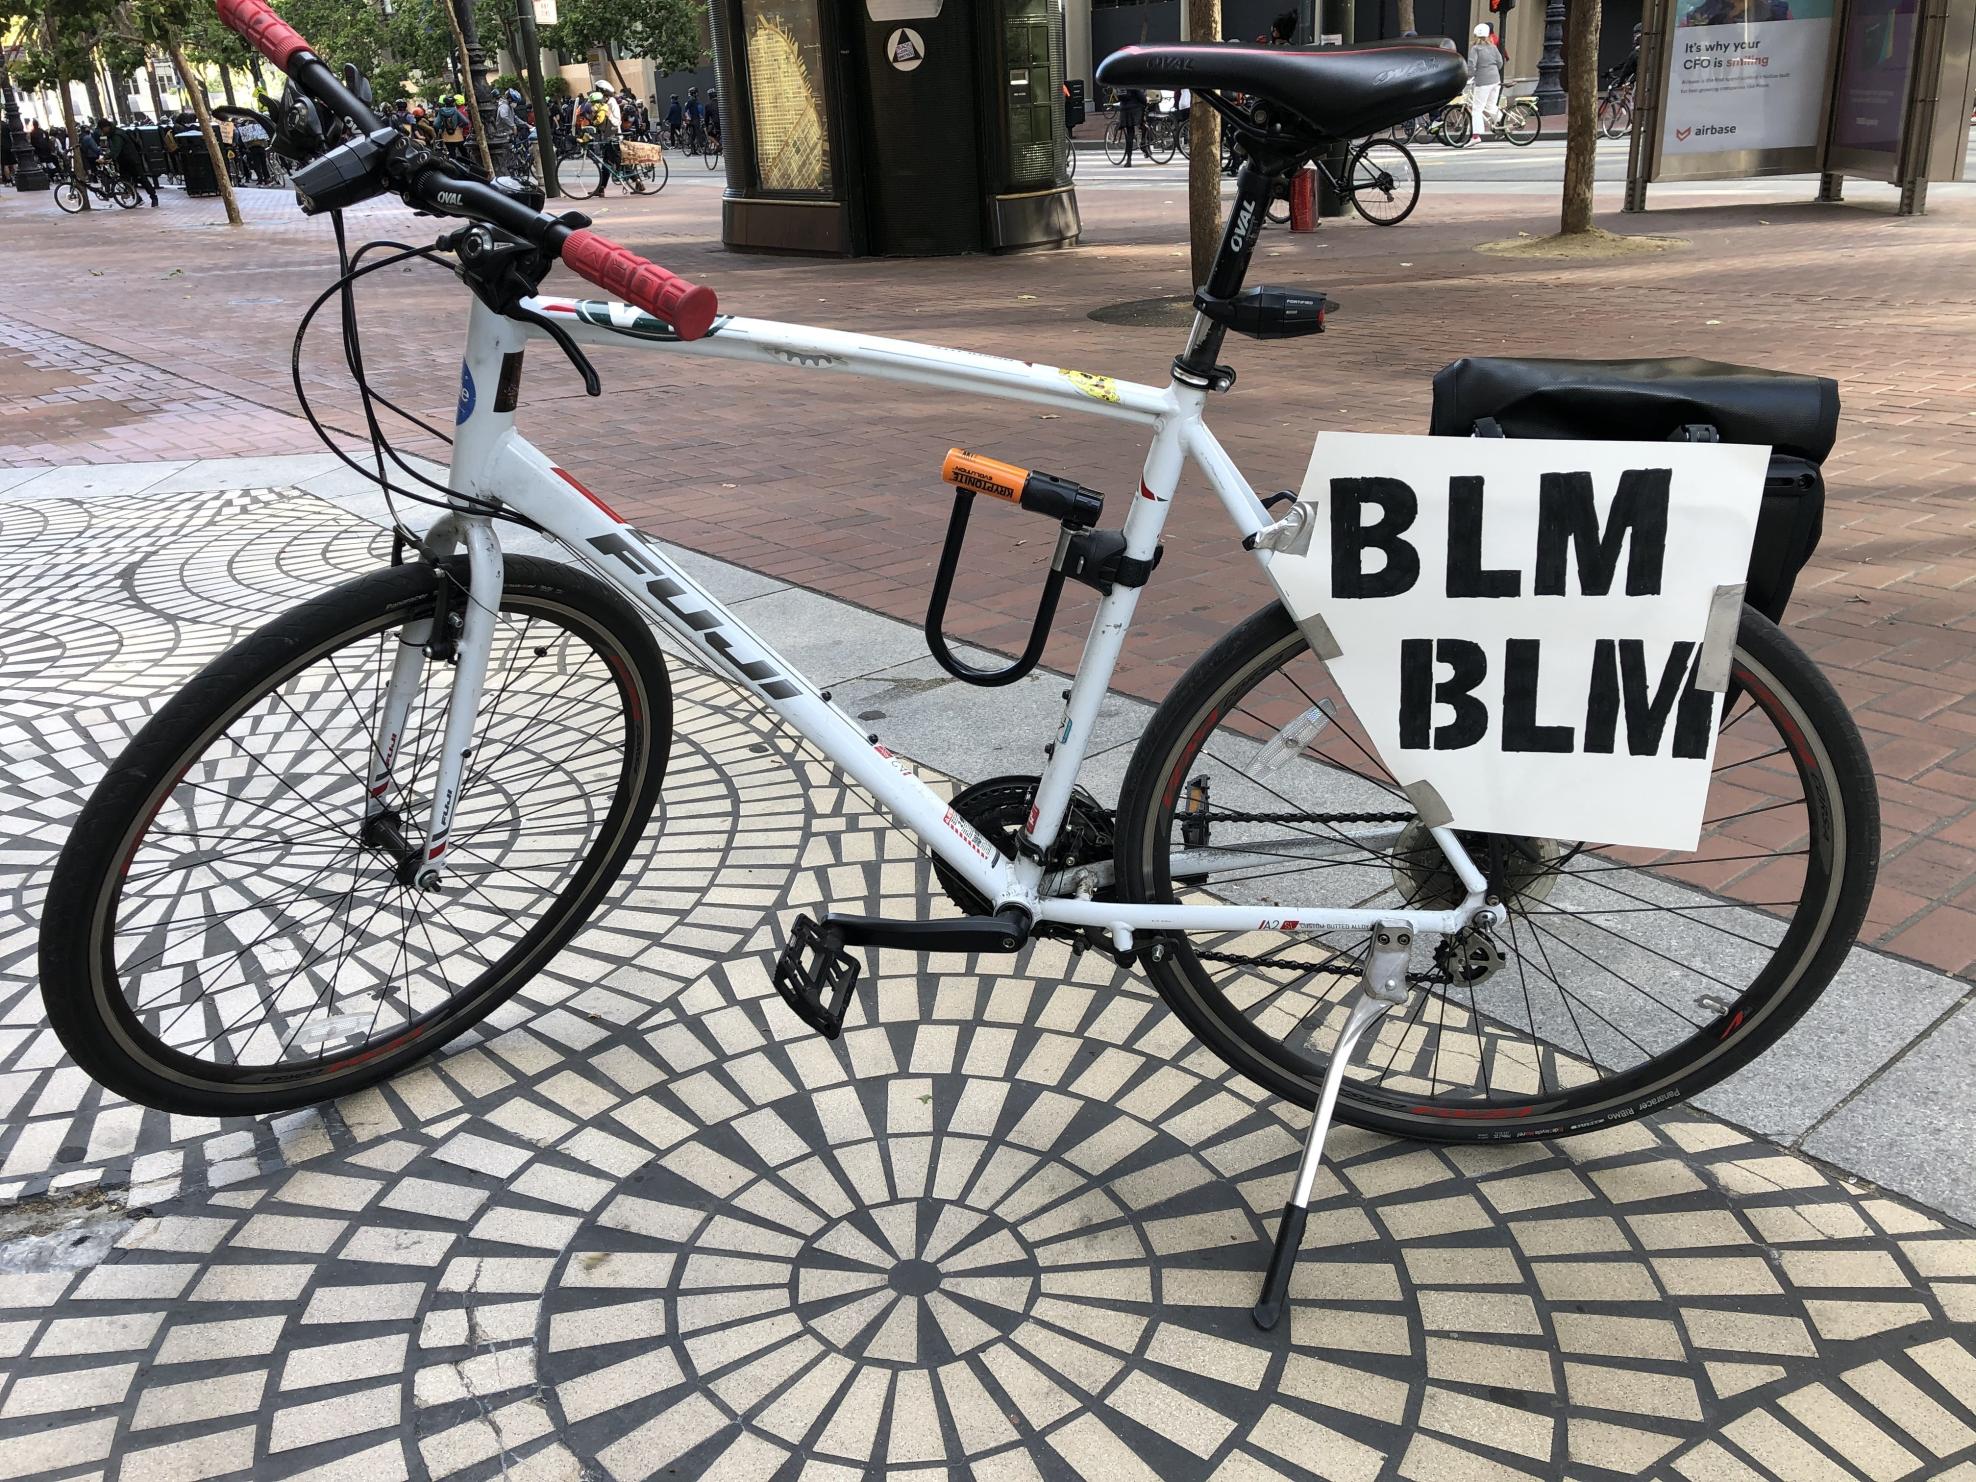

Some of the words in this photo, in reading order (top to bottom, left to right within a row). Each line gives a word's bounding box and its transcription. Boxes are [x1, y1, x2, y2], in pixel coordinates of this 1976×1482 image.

[1685, 42, 1702, 54] It's
[1705, 40, 1730, 54] why
[1733, 40, 1761, 53] your
[1683, 57, 1711, 70] CFO
[1713, 57, 1723, 68] is
[1726, 55, 1769, 67] smiling
[1695, 124, 1737, 136] airbase
[437, 191, 463, 205] OVAL
[1231, 200, 1256, 252] OVAL
[952, 470, 1014, 498] KRYPTONITE
[1330, 468, 1672, 599] BLM
[585, 532, 804, 701] FUJI
[1399, 638, 1716, 760] BLM
[441, 788, 453, 826] FUJI
[1639, 1087, 1681, 1111] Panaracer
[1607, 1107, 1635, 1120] RIBMo
